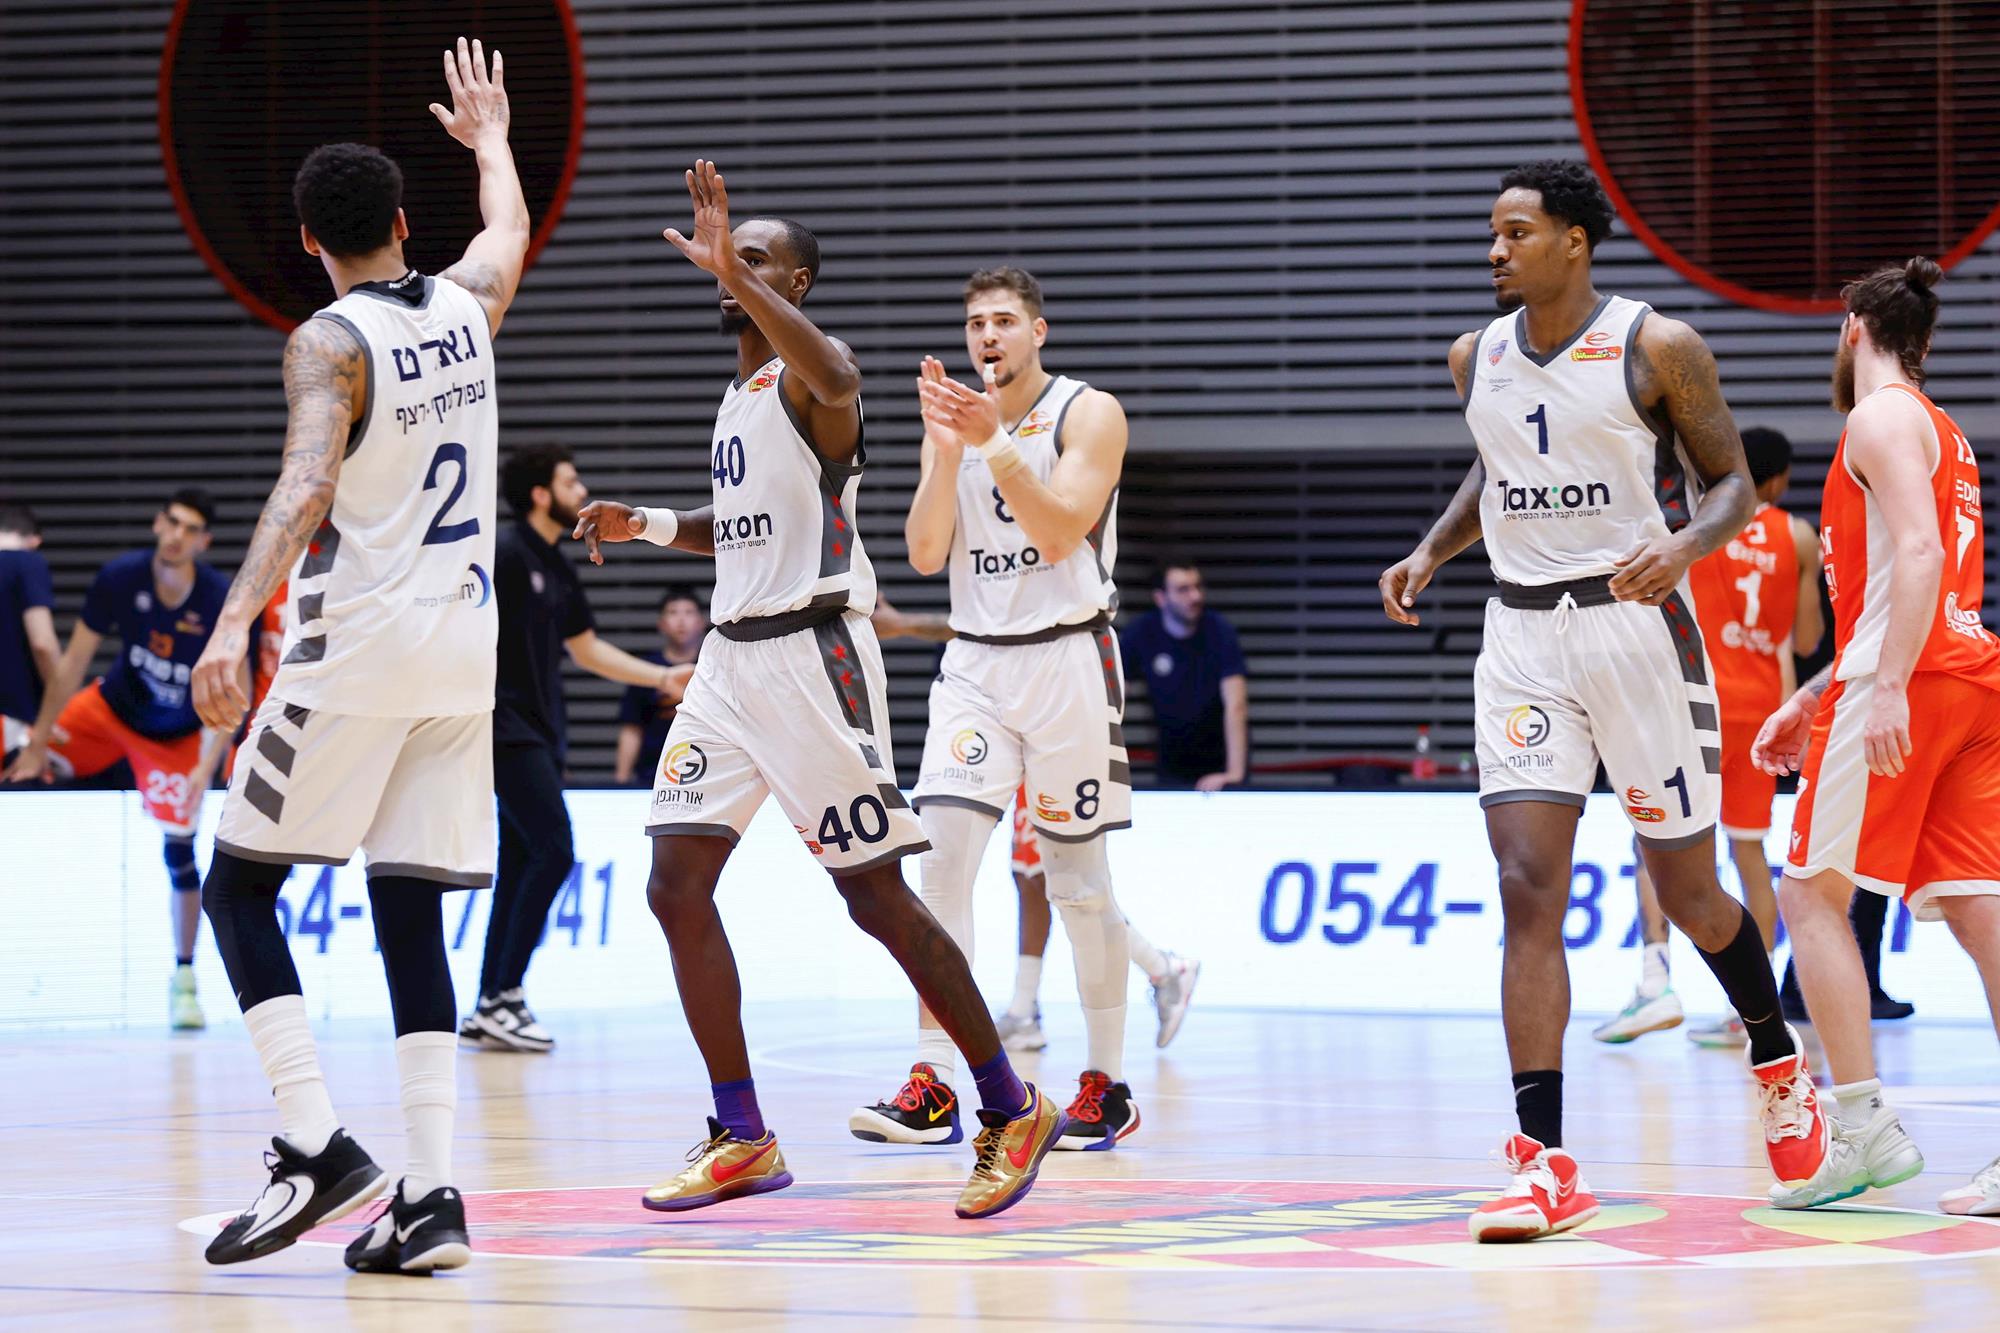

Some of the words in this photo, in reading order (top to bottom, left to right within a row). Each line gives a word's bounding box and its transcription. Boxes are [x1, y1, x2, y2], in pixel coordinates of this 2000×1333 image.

[1525, 403, 1549, 455] 1
[713, 435, 746, 489] 40
[422, 442, 481, 546] 2
[714, 512, 773, 545] ax:on
[1735, 570, 1762, 628] 1
[656, 789, 681, 806] הגפן
[683, 790, 704, 805] אור
[1075, 778, 1101, 820] 8
[1663, 766, 1692, 818] 1
[817, 794, 889, 854] 40
